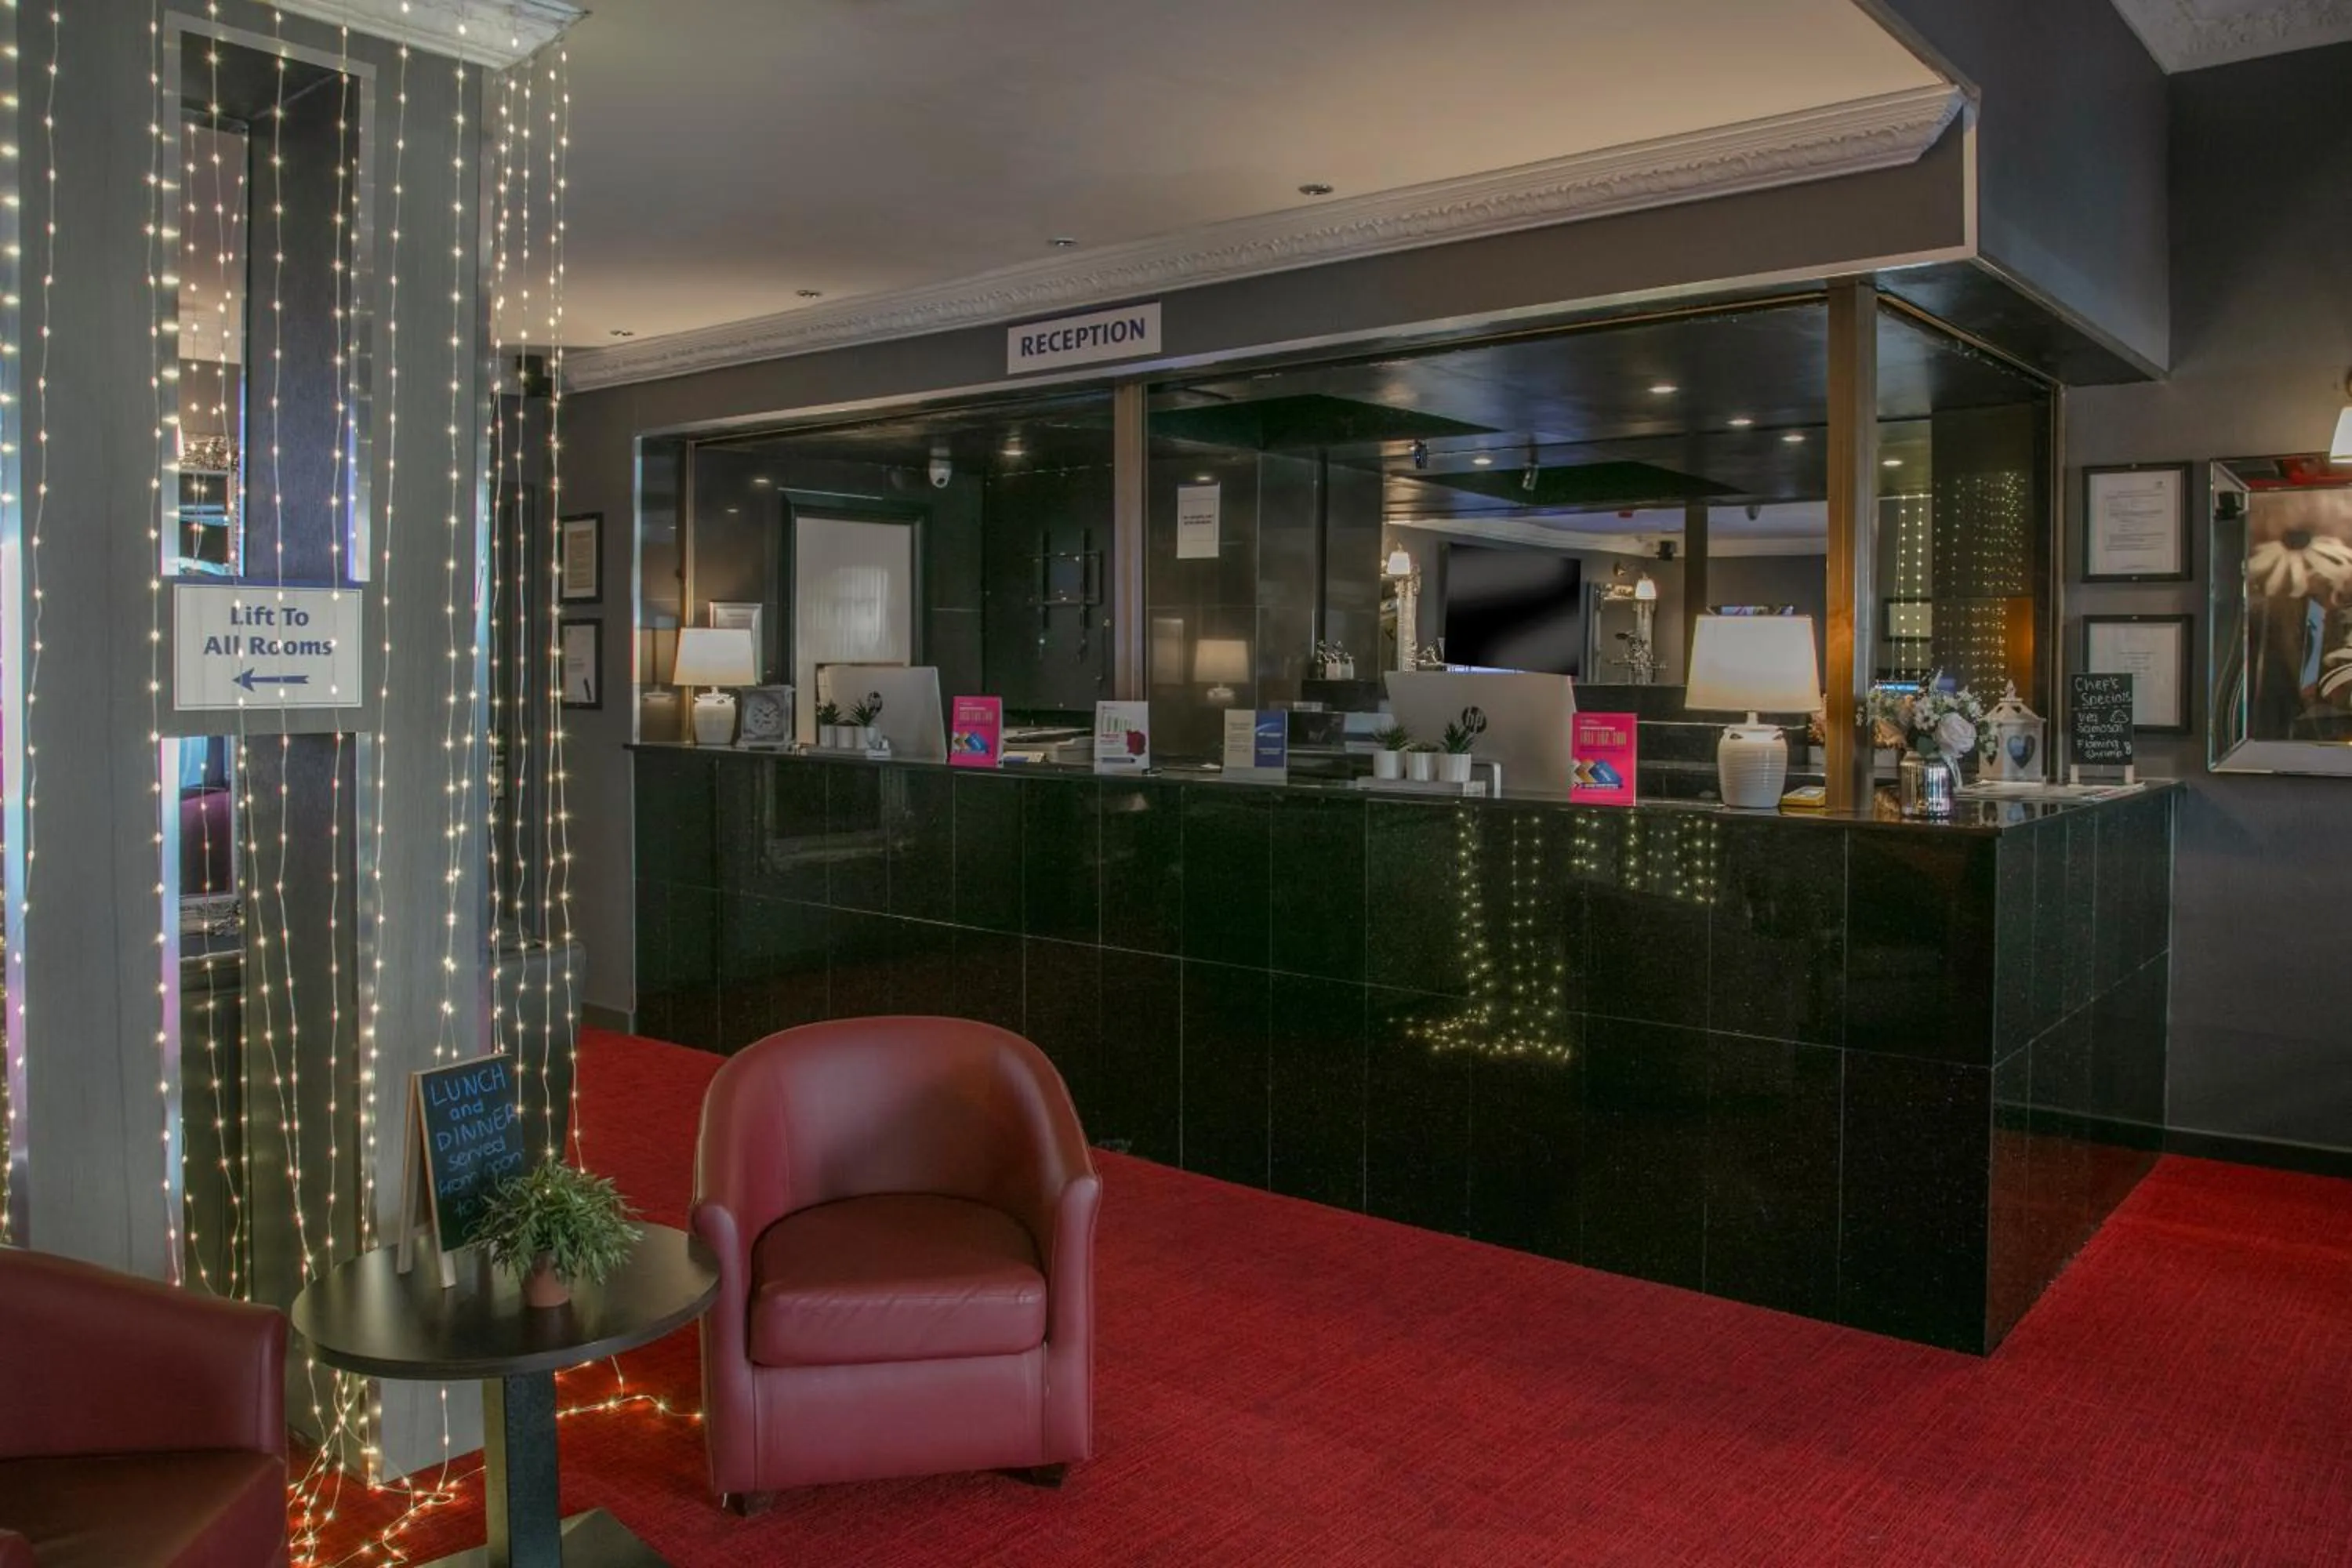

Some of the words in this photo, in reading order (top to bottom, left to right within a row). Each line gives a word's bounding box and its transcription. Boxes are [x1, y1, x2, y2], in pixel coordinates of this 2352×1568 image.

[1021, 317, 1145, 358] RECEPTION
[230, 606, 275, 626] Lift
[281, 608, 310, 626] To
[203, 636, 240, 655] All
[250, 637, 332, 655] Rooms
[1463, 706, 1486, 734] hp
[430, 1062, 506, 1106] LUNCH
[451, 1098, 483, 1120] and
[436, 1102, 517, 1152] DINNER
[448, 1136, 506, 1172] served
